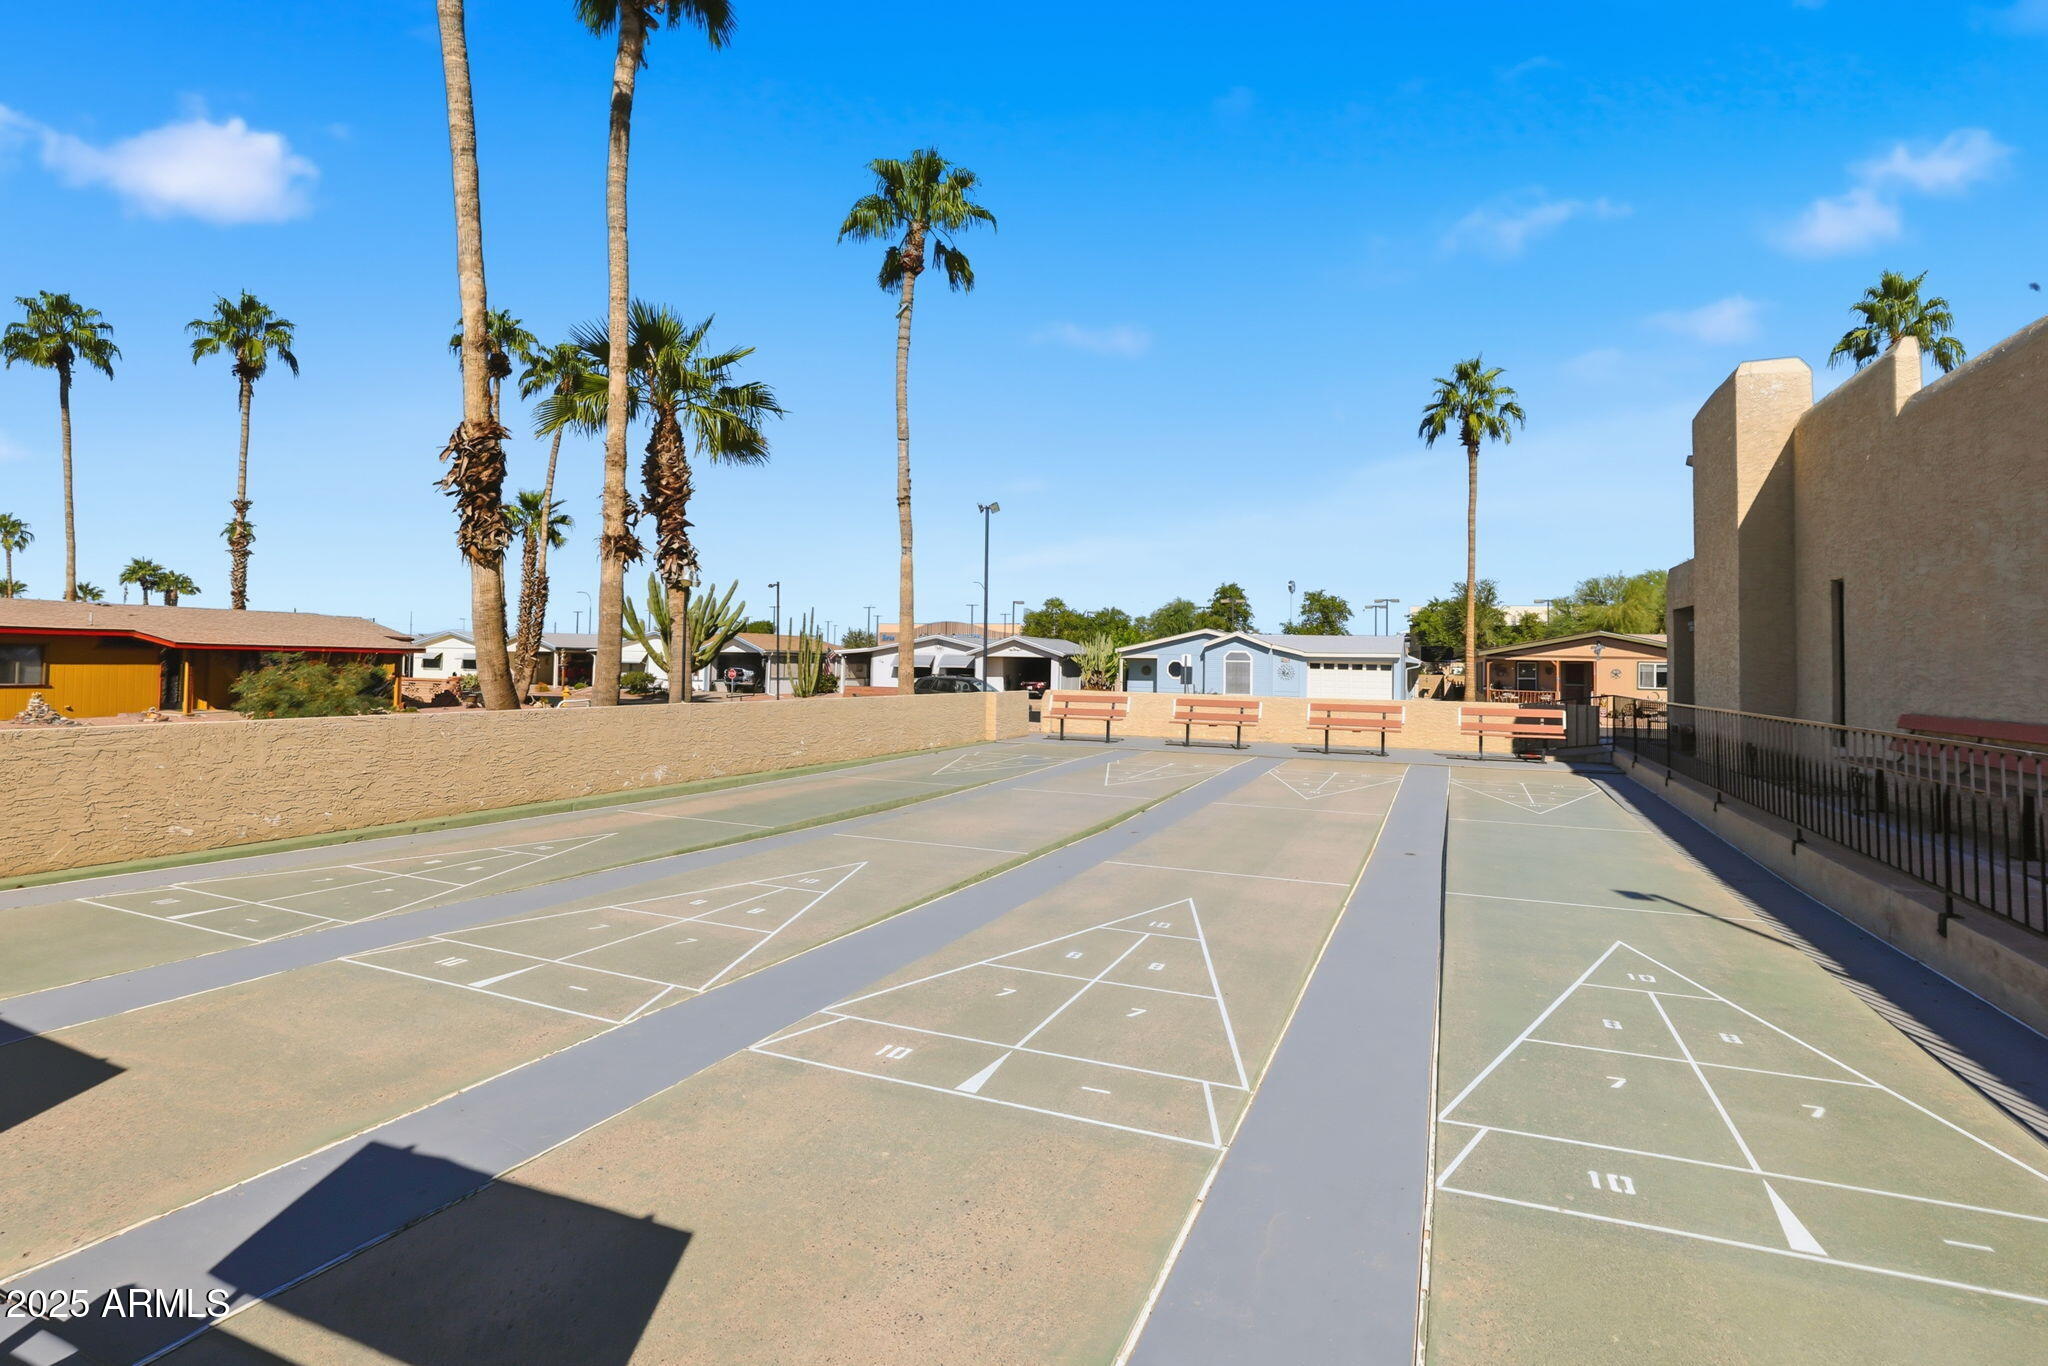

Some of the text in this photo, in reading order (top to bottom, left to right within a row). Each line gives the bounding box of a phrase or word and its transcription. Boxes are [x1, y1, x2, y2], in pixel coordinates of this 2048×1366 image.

[1148, 920, 1172, 930] 10
[1147, 962, 1166, 971] 8
[1626, 972, 1657, 983] 10
[995, 987, 1017, 997] 7
[1126, 1007, 1148, 1018] 7
[1601, 1018, 1624, 1030] 8
[1718, 1032, 1744, 1045] 8
[874, 1044, 914, 1061] 10
[1606, 1075, 1627, 1089] 7
[1801, 1103, 1826, 1119] 7
[1587, 1169, 1637, 1196] 10
